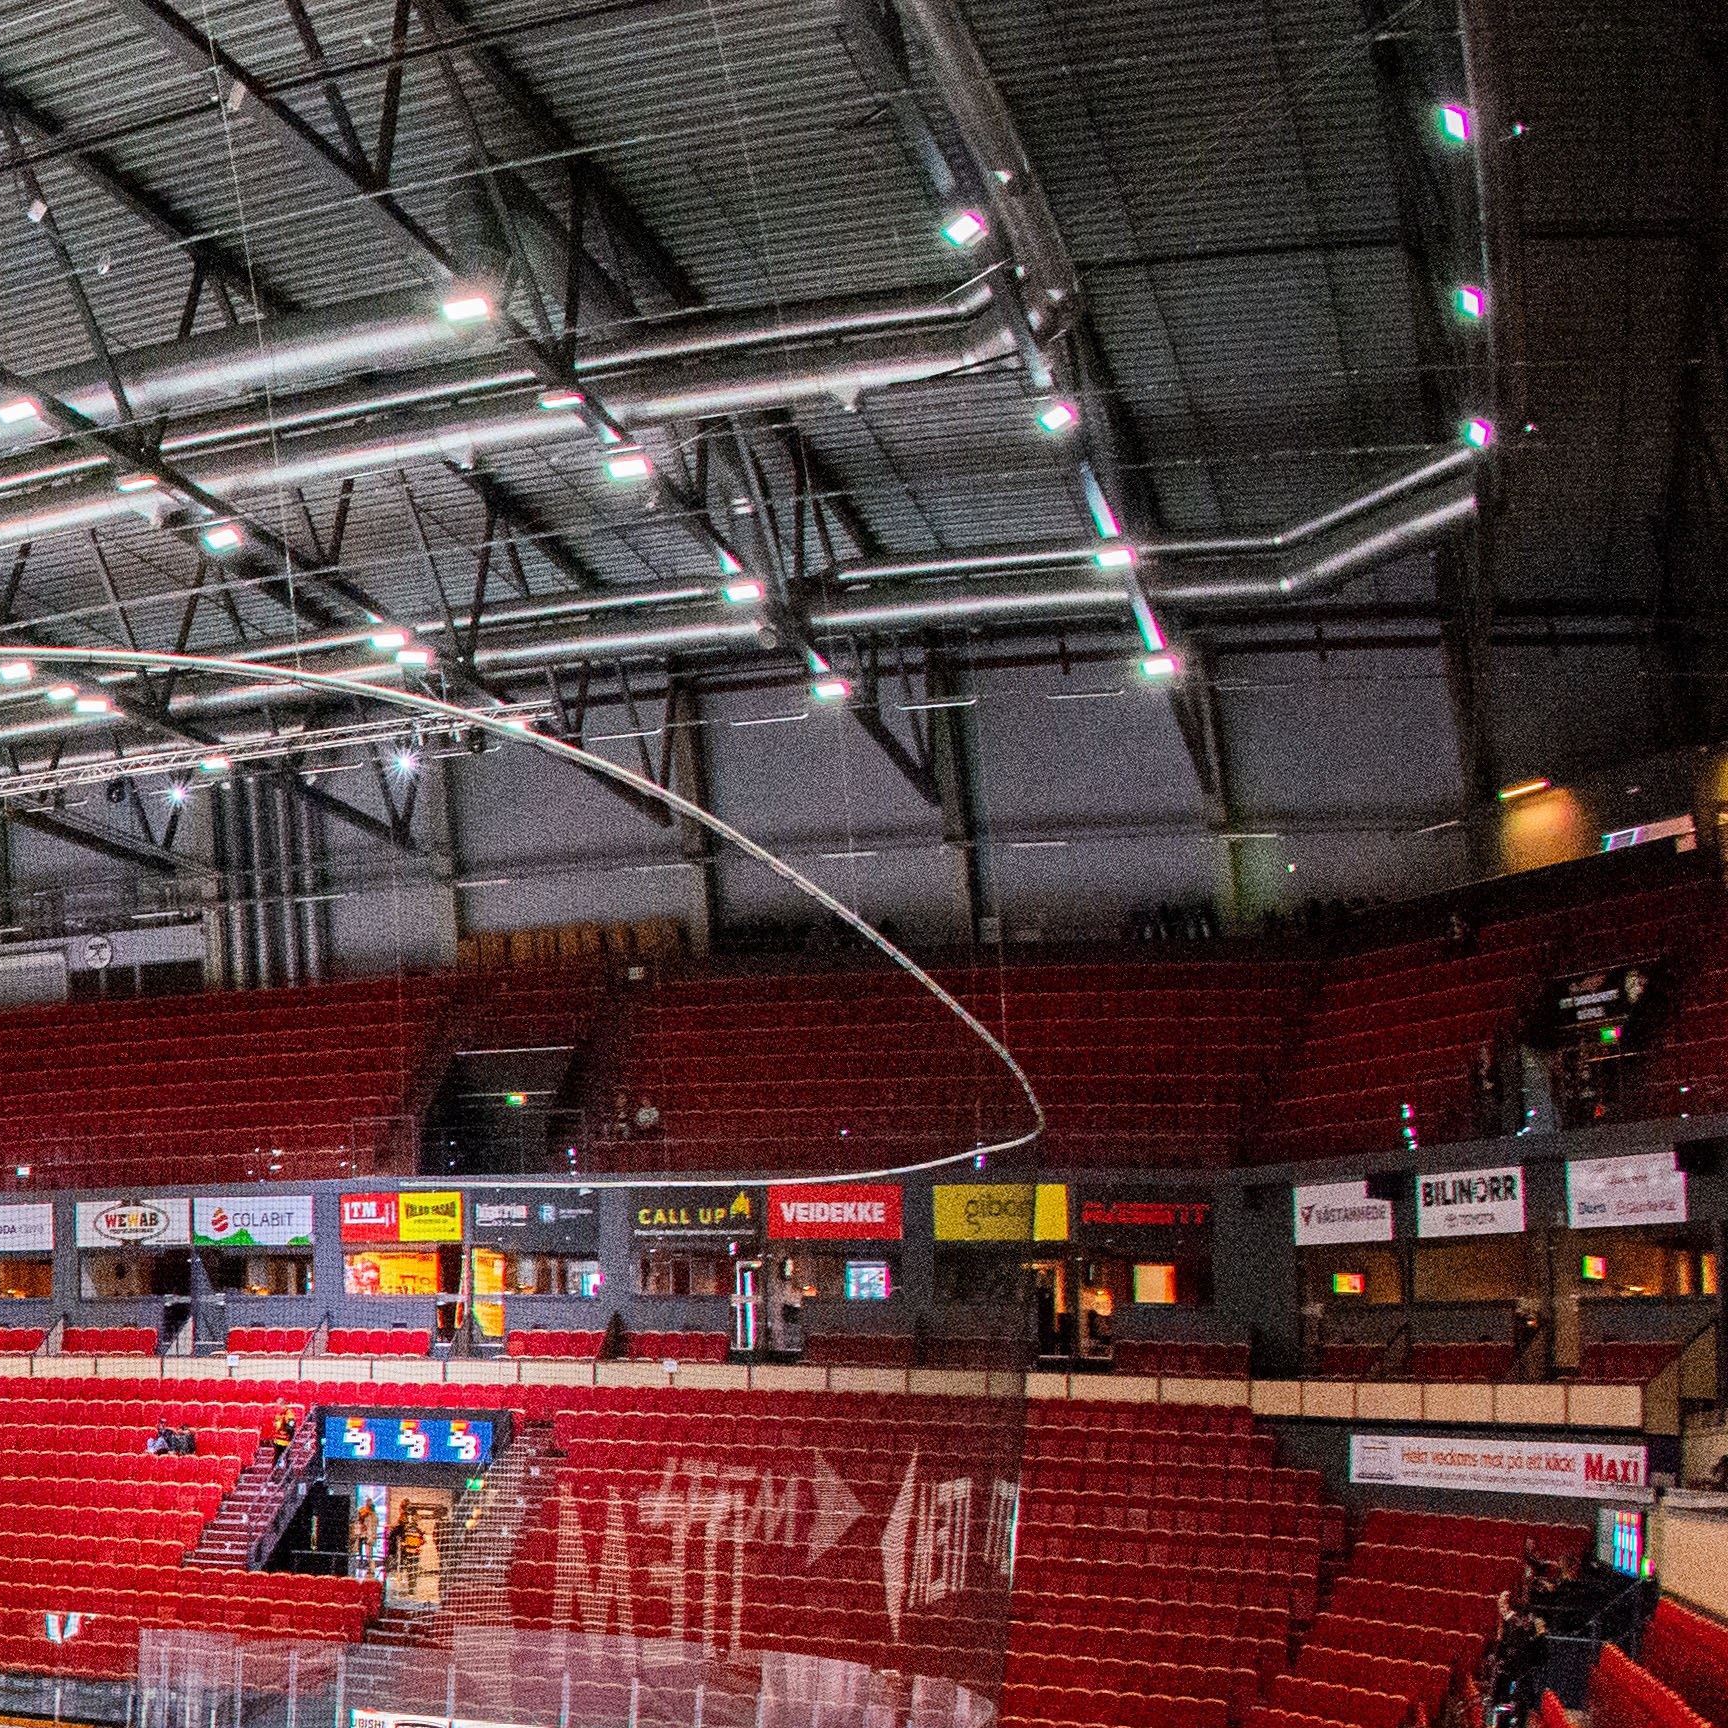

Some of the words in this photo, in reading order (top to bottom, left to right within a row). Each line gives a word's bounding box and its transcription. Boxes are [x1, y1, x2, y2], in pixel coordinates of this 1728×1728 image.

[104, 1212, 159, 1228] WEWAB
[638, 1208, 692, 1225] CALL
[698, 1207, 726, 1224] UP
[779, 1201, 886, 1223] VEIDEKKE
[1583, 1452, 1640, 1484] MAXI
